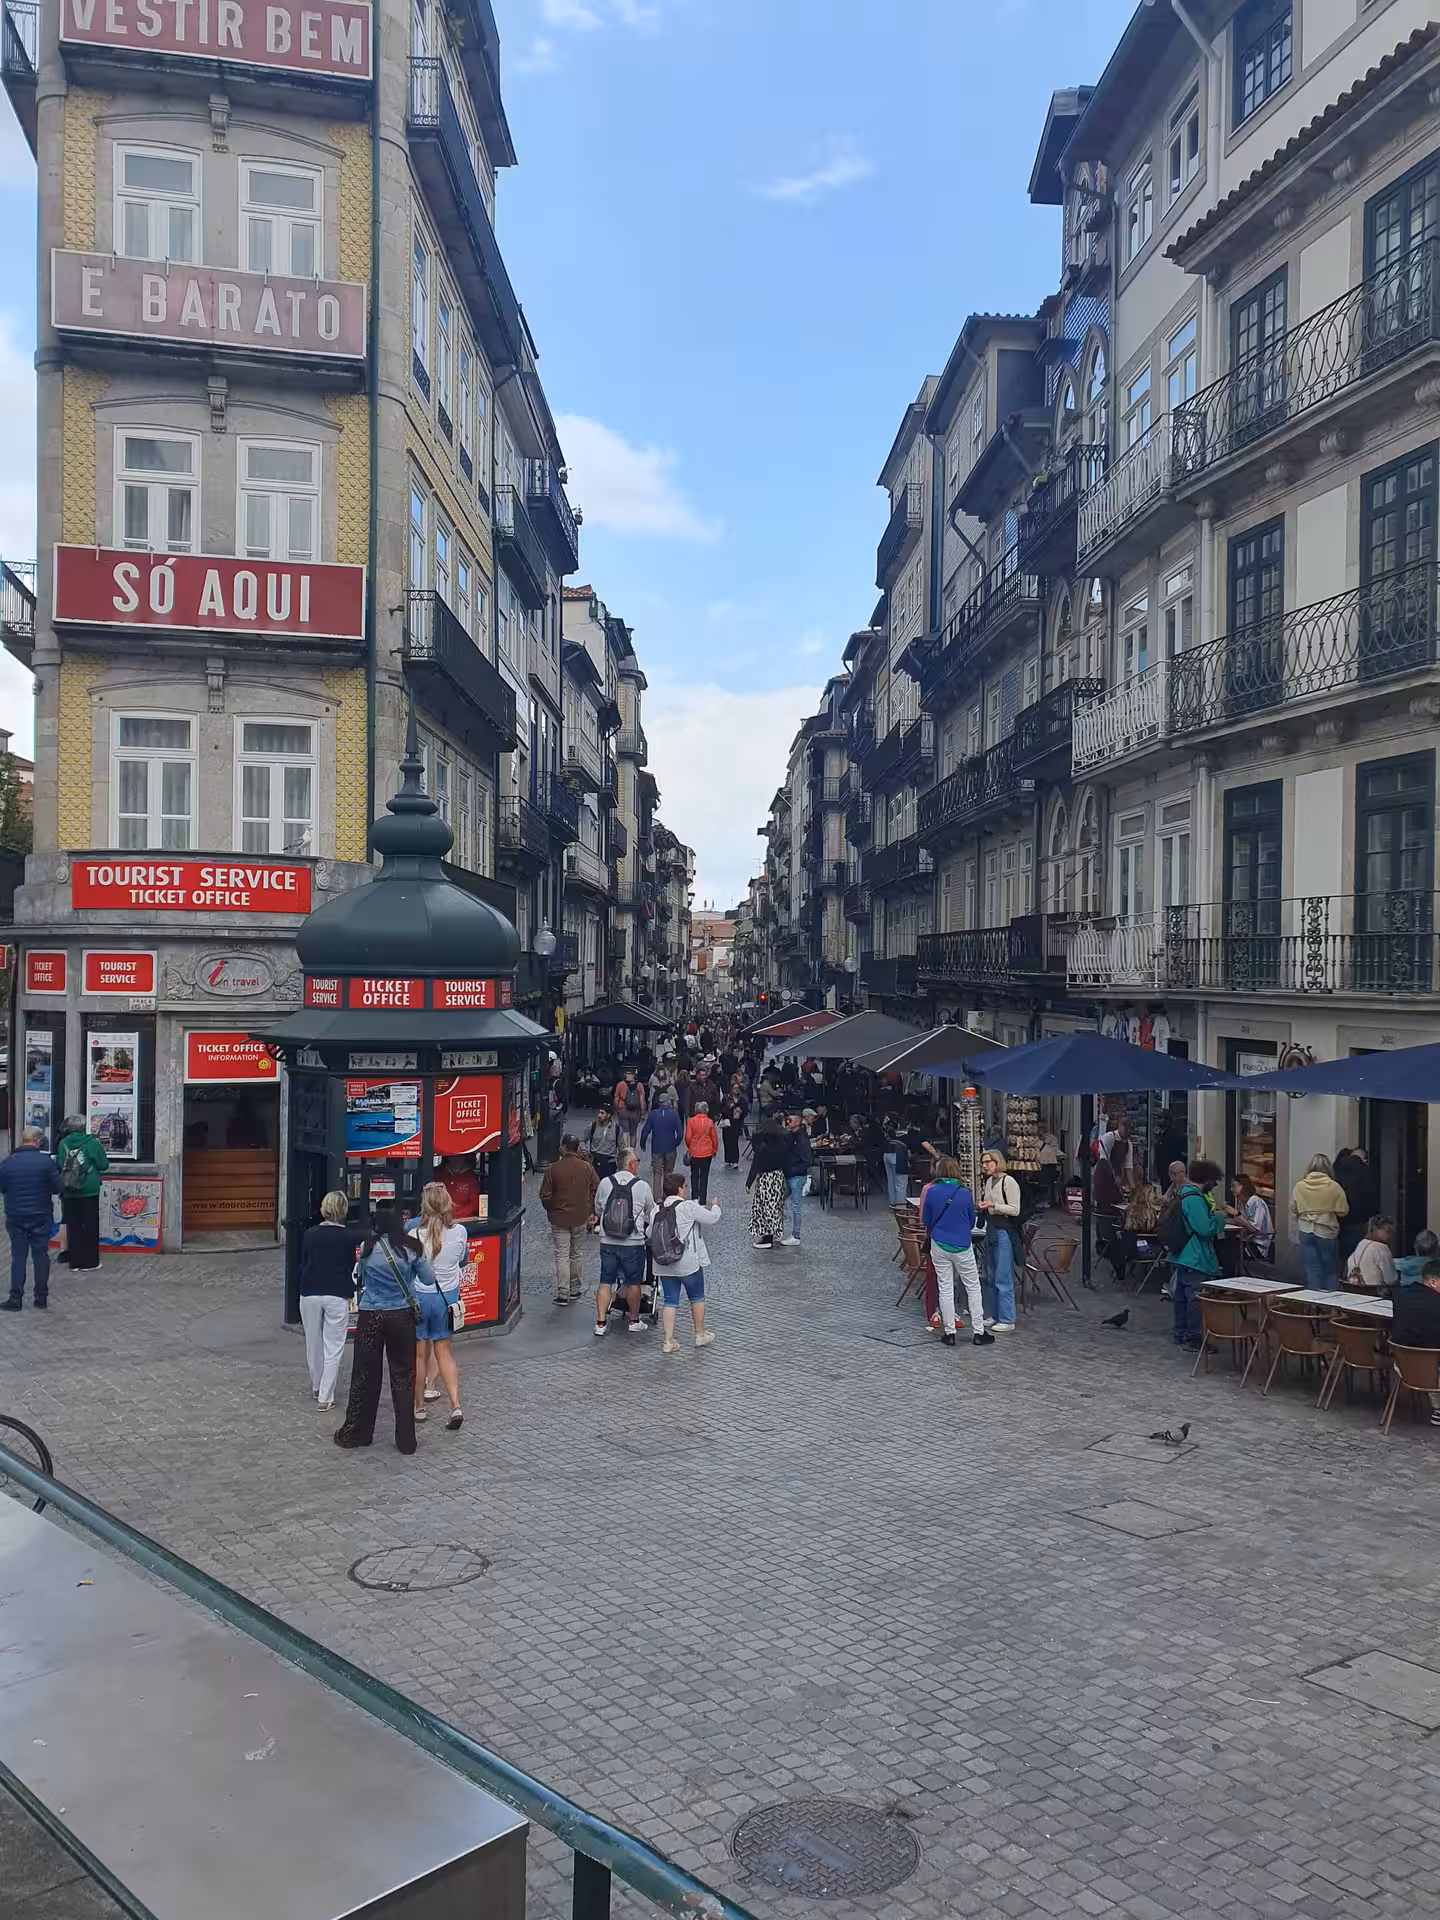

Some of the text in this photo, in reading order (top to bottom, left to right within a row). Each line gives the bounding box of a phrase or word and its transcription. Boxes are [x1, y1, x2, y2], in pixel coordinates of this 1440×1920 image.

[71, 0, 363, 65] VESTIR BEM
[81, 265, 341, 342] E BARATO
[112, 557, 311, 623] SÓ AQUI
[86, 866, 297, 891] TOURIST SERVICE
[129, 889, 251, 906] TICKET OFFICE
[33, 961, 54, 971] TICKET
[99, 961, 137, 971] TOURIST
[33, 973, 53, 982] OFFICE
[99, 974, 137, 984] SERVICE
[232, 976, 260, 987] travel
[312, 979, 338, 991] TOURIST
[363, 980, 411, 993] TICKET
[444, 981, 487, 992] TOURIST
[312, 992, 337, 1004] SERVICE
[362, 993, 411, 1006] OFFICE
[445, 994, 486, 1006] SERVICE
[197, 1043, 266, 1053] TICKET OFFICE
[207, 1054, 259, 1062] INFORMATION
[456, 1100, 481, 1109] TICKET
[456, 1109, 481, 1118] OFFICE
